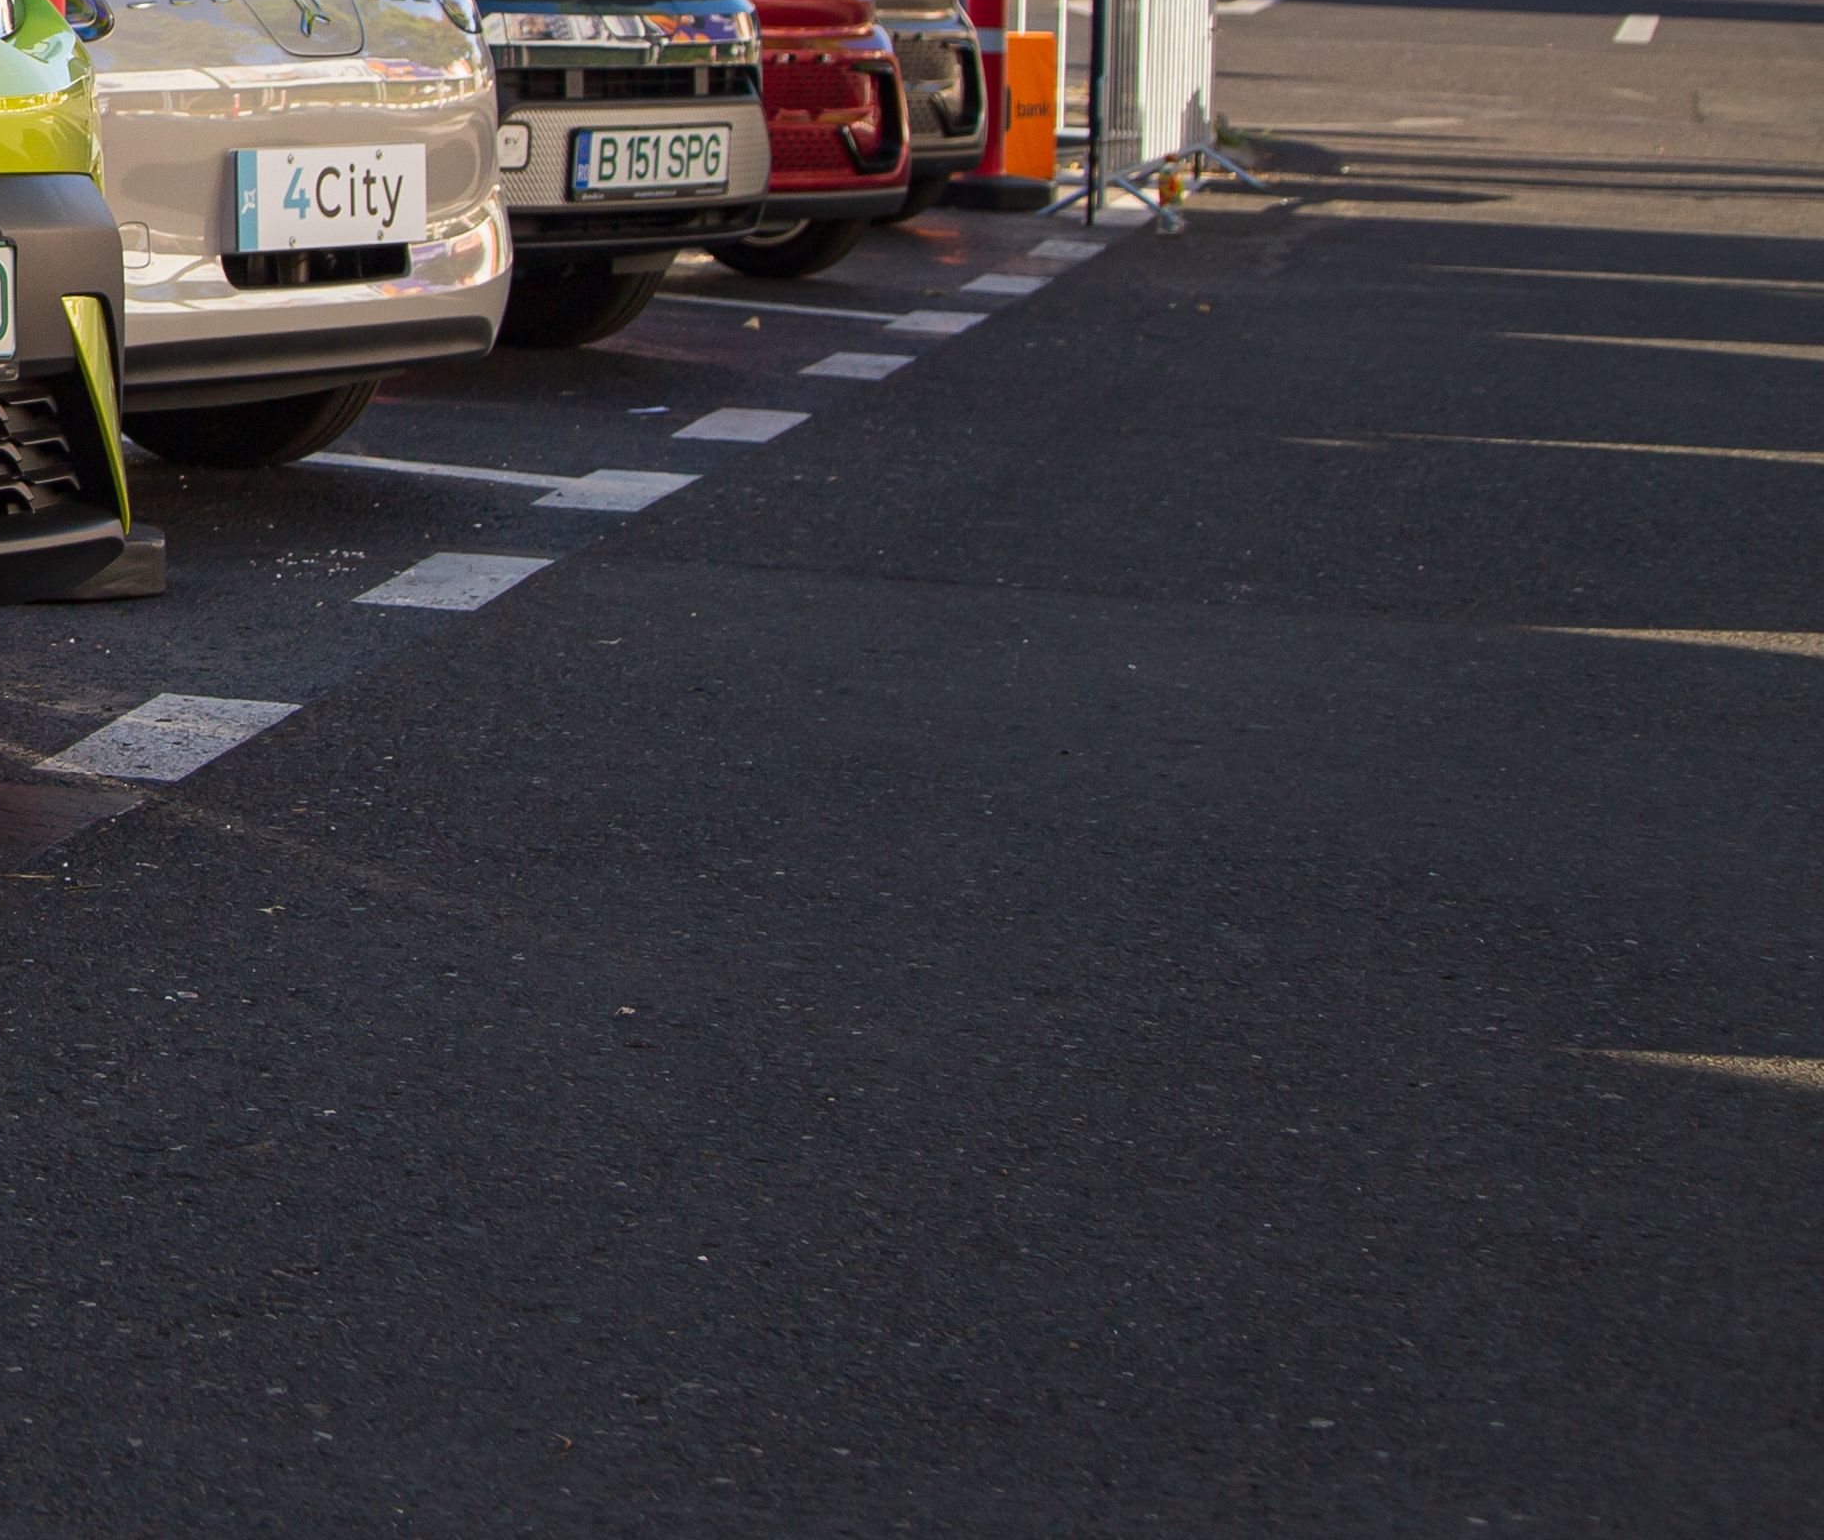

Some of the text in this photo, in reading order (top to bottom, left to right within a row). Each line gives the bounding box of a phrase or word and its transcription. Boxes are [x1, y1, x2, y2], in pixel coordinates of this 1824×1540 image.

[1017, 100, 1051, 118] bank
[598, 133, 722, 181] B 151 SPG
[282, 161, 404, 228] 4City
